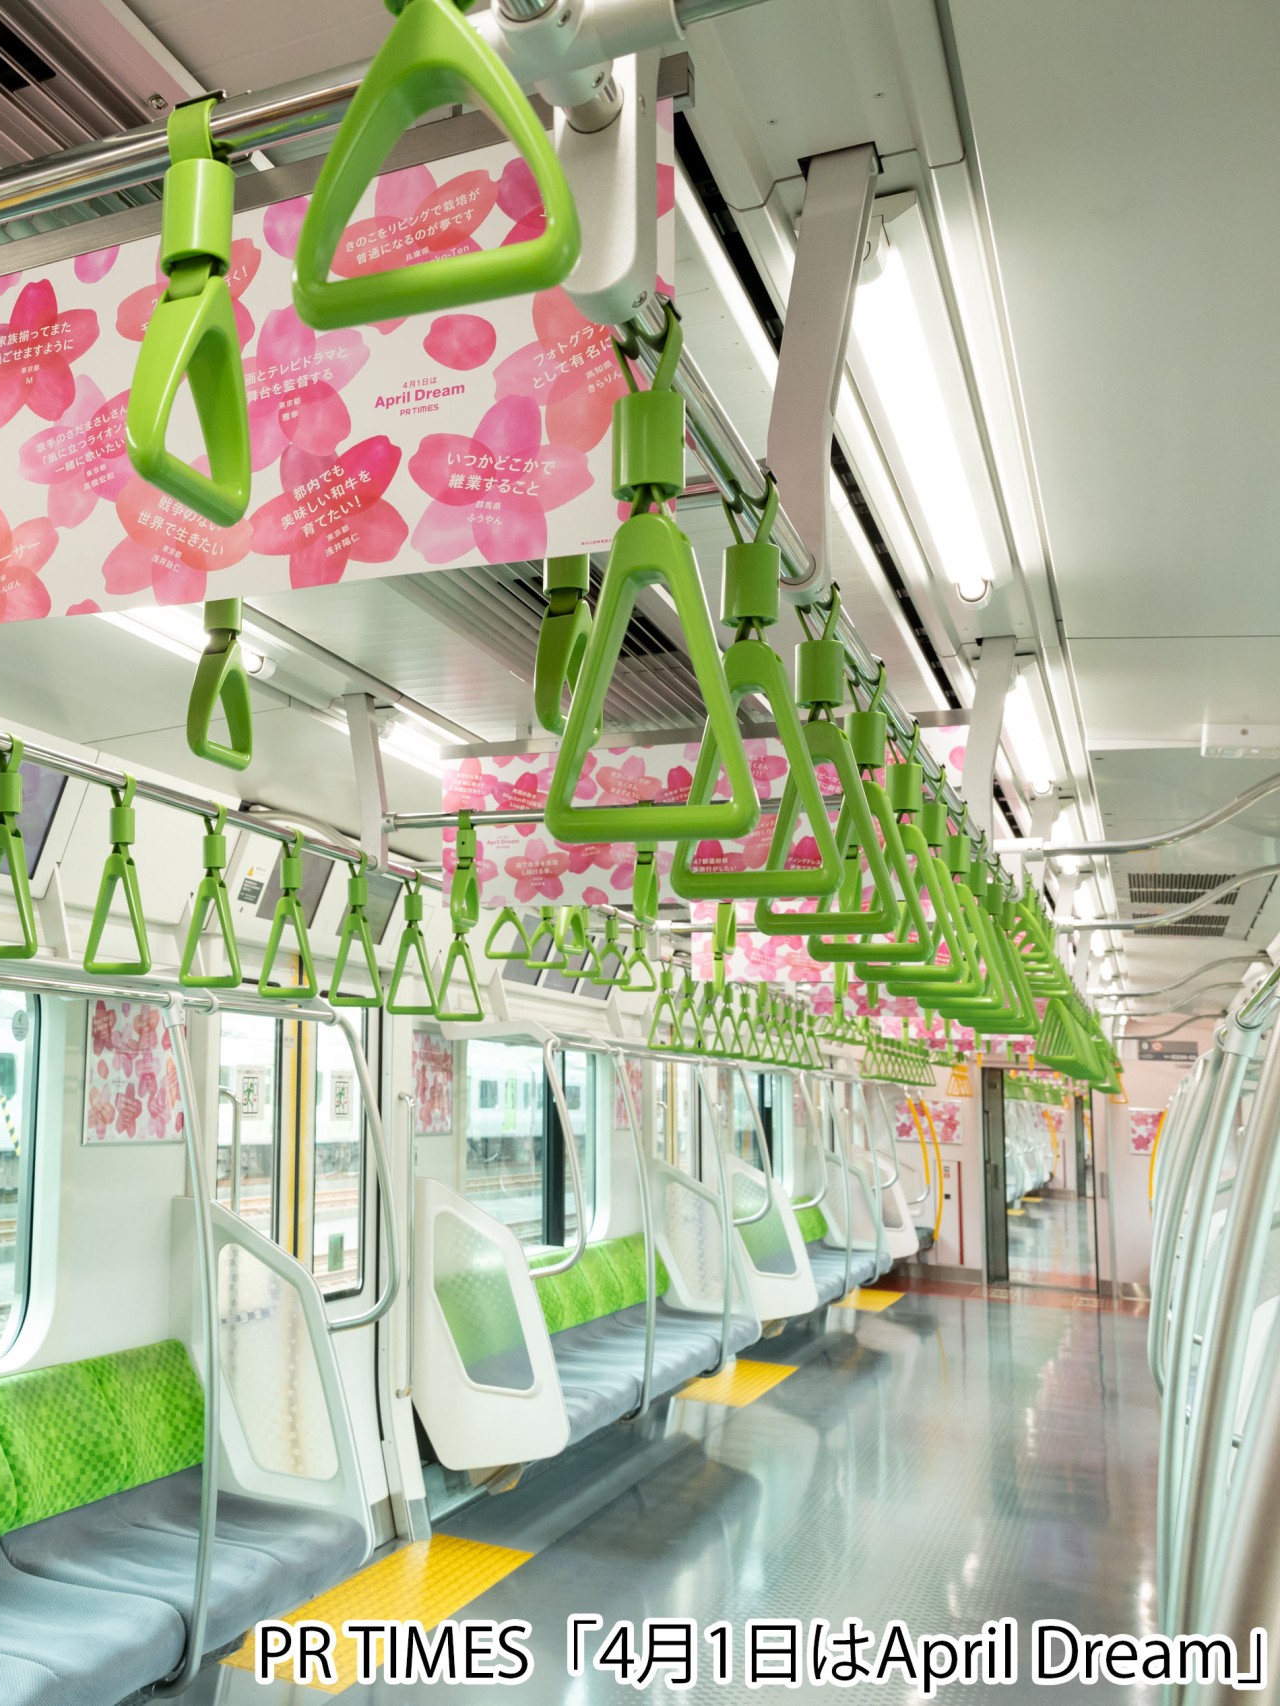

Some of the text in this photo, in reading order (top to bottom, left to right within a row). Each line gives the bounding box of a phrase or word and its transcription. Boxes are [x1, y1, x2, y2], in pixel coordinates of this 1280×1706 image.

[346, 187, 481, 252] きのこをリビングで栽培が
[356, 209, 475, 265] 普通になるのが夢です
[21, 364, 41, 375] 東京都
[25, 376, 33, 385] M
[586, 360, 613, 379] 高知県
[246, 368, 334, 401] 舞台を監督する
[403, 377, 437, 389] 4月1日は
[374, 384, 465, 410] April Dream
[412, 404, 439, 414] TIMES
[36, 405, 128, 453] 歌手のさだまさしさん
[54, 438, 126, 473] 一緒に歌いたい
[447, 452, 557, 475] いつかどこかで
[86, 463, 107, 478] 東京都
[293, 465, 345, 501] 都内でも
[448, 473, 540, 496] 継業すること
[281, 470, 372, 530] 美味しい和牛を
[301, 495, 361, 537] 育てたい！
[467, 513, 503, 526] ふうやん
[137, 510, 224, 556] 世界で生きたい
[326, 524, 350, 542] 東京都
[162, 545, 183, 559] 東京都
